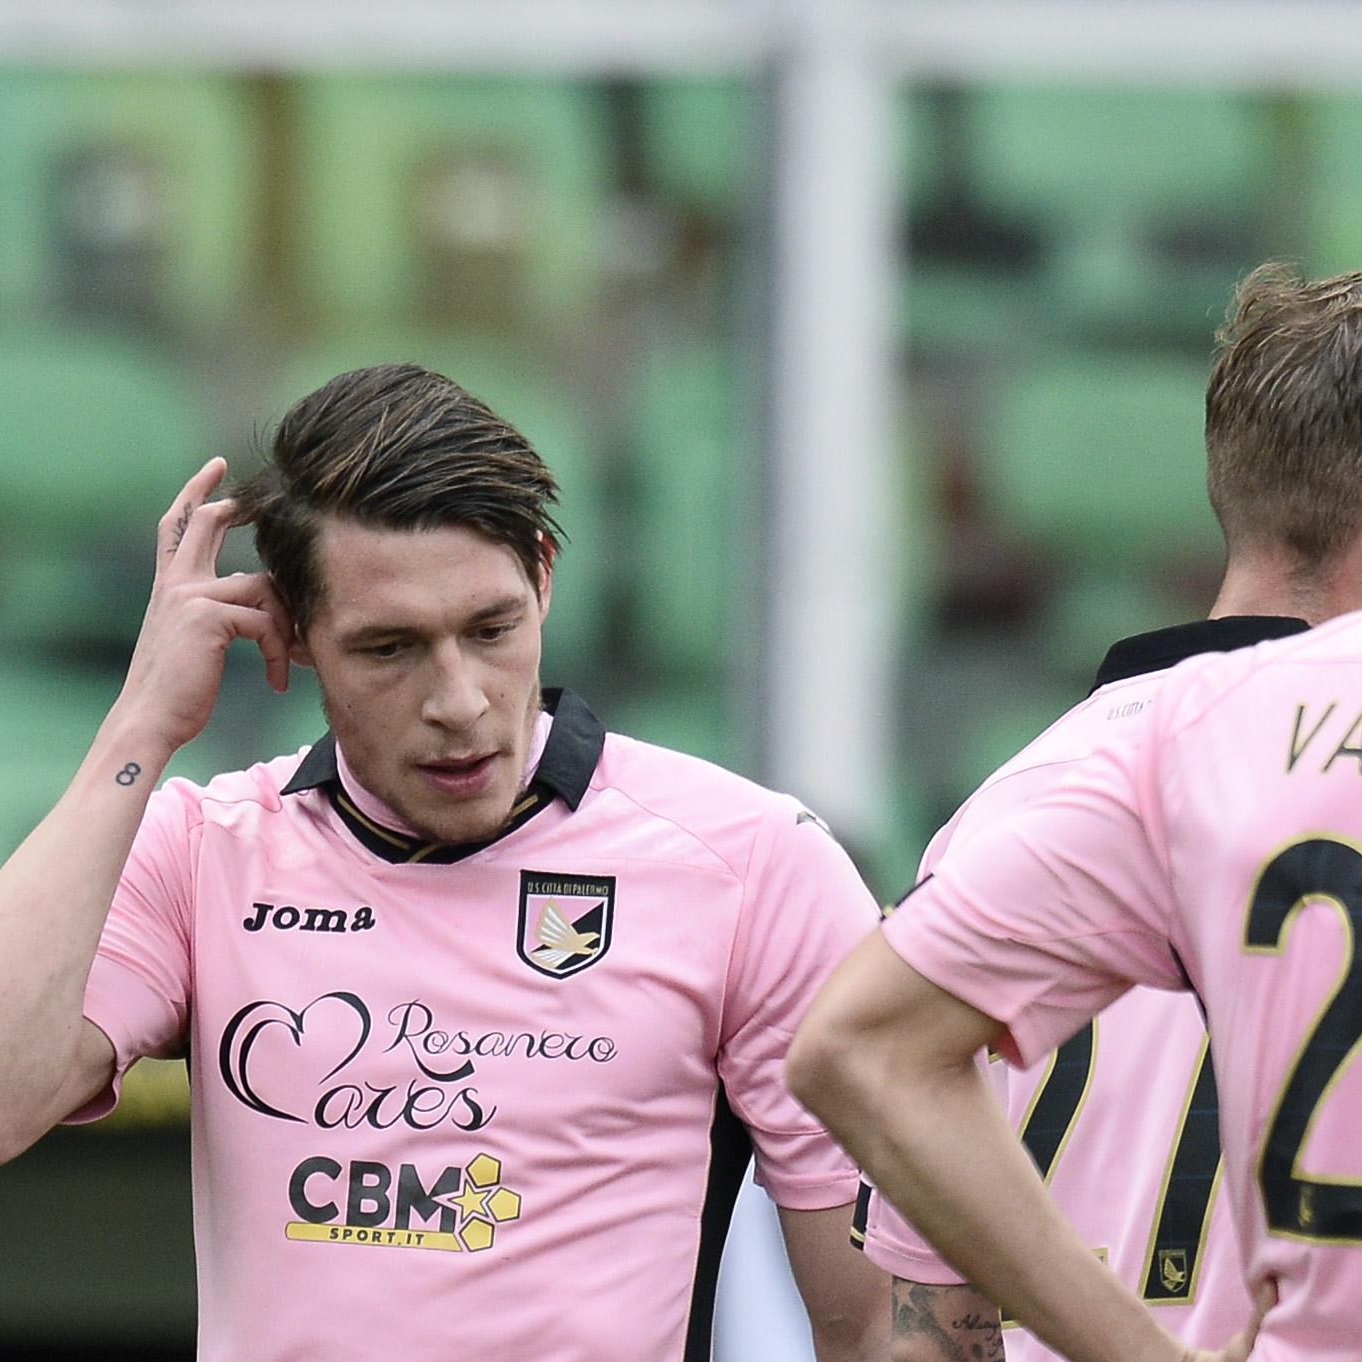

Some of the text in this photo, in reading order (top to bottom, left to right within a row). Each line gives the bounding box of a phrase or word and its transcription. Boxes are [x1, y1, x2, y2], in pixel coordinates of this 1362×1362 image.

[383, 999, 618, 1082] Rosanero
[288, 1155, 461, 1232] CBM
[329, 1227, 425, 1247] SPORT.IT
